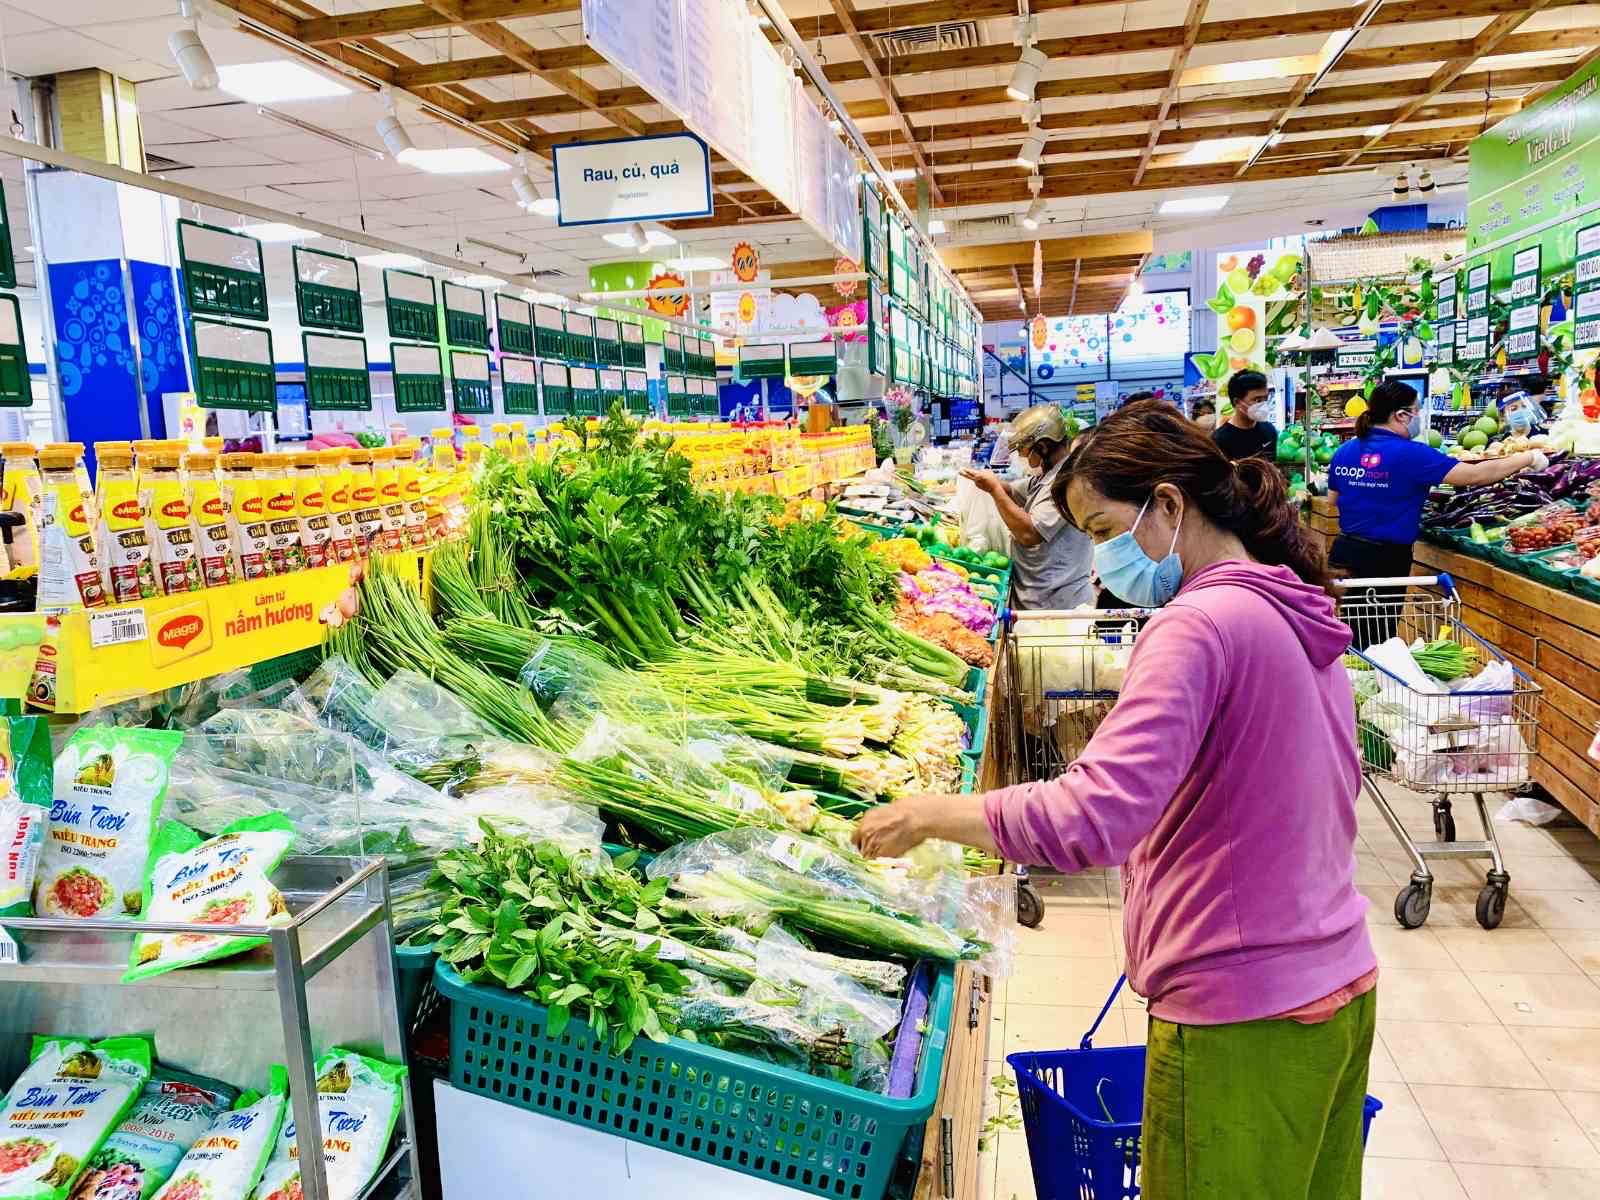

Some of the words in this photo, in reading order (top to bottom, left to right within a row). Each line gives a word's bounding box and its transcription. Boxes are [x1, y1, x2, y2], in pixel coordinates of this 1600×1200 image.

[583, 167, 618, 183] Rau,
[622, 163, 646, 180] củ,
[650, 159, 680, 179] quả
[255, 593, 274, 606] Làm
[225, 609, 262, 637] nấm
[265, 601, 313, 628] hương
[163, 622, 199, 641] Maggi
[49, 799, 82, 825] Bún
[90, 803, 130, 832] Tươi
[16, 1087, 58, 1107] Bún
[323, 1138, 351, 1153] ANG
